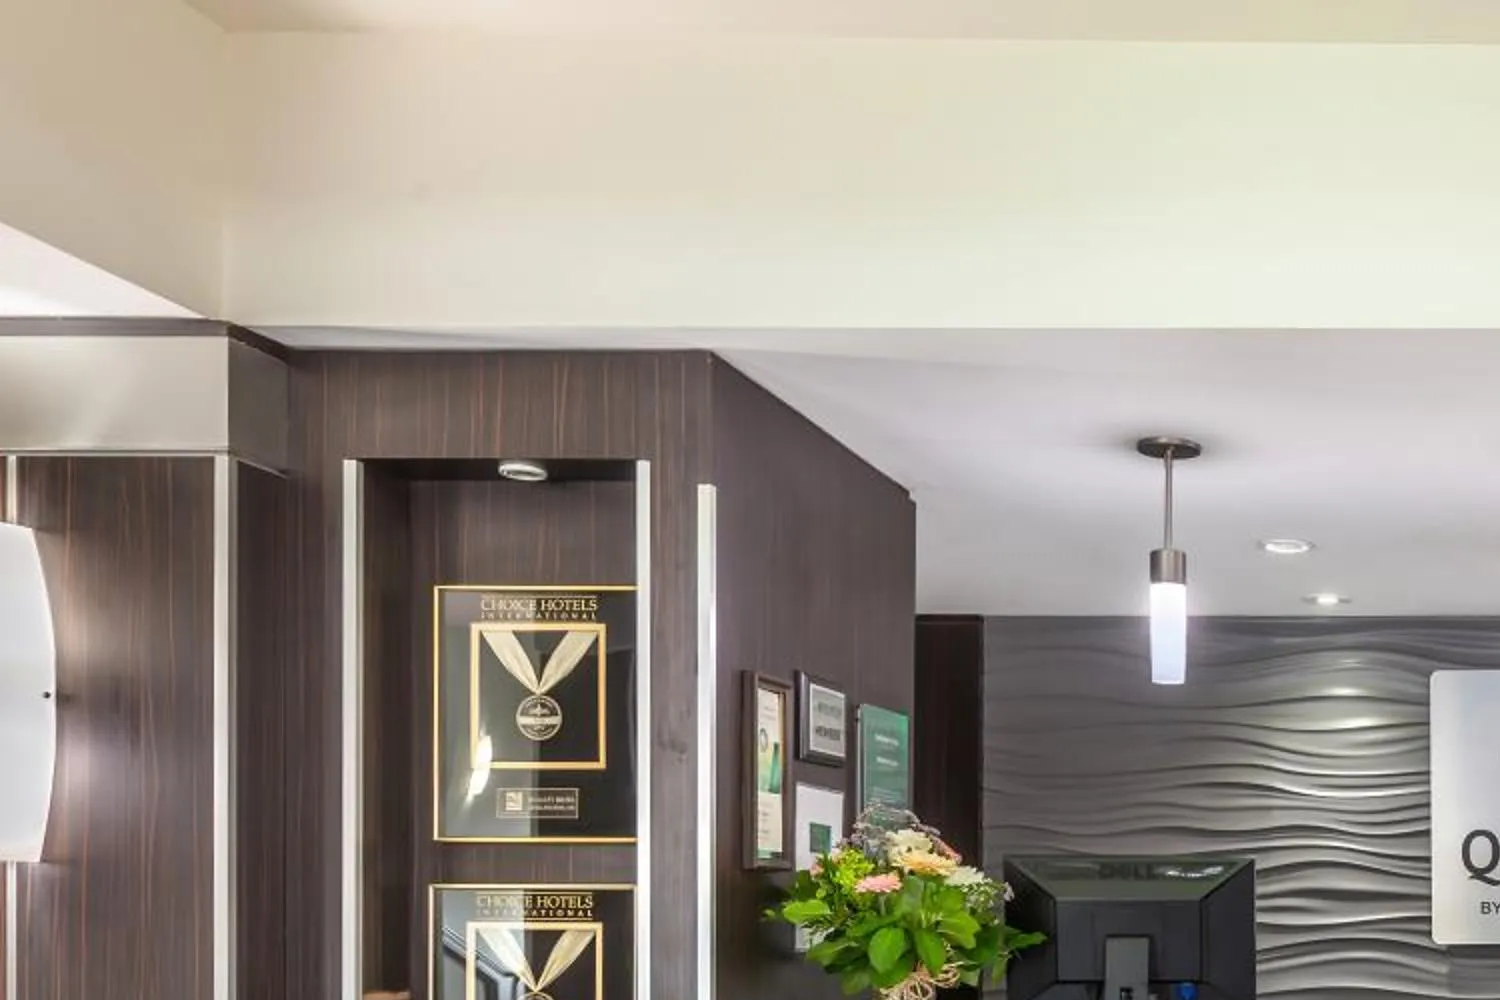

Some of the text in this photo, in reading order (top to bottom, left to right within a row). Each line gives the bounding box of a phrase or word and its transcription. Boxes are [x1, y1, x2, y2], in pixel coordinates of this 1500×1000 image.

[480, 599, 598, 611] CHOICE HOTELS
[480, 611, 596, 619] INTERNATIONAL
[475, 895, 593, 909] CHOICE HOTELS
